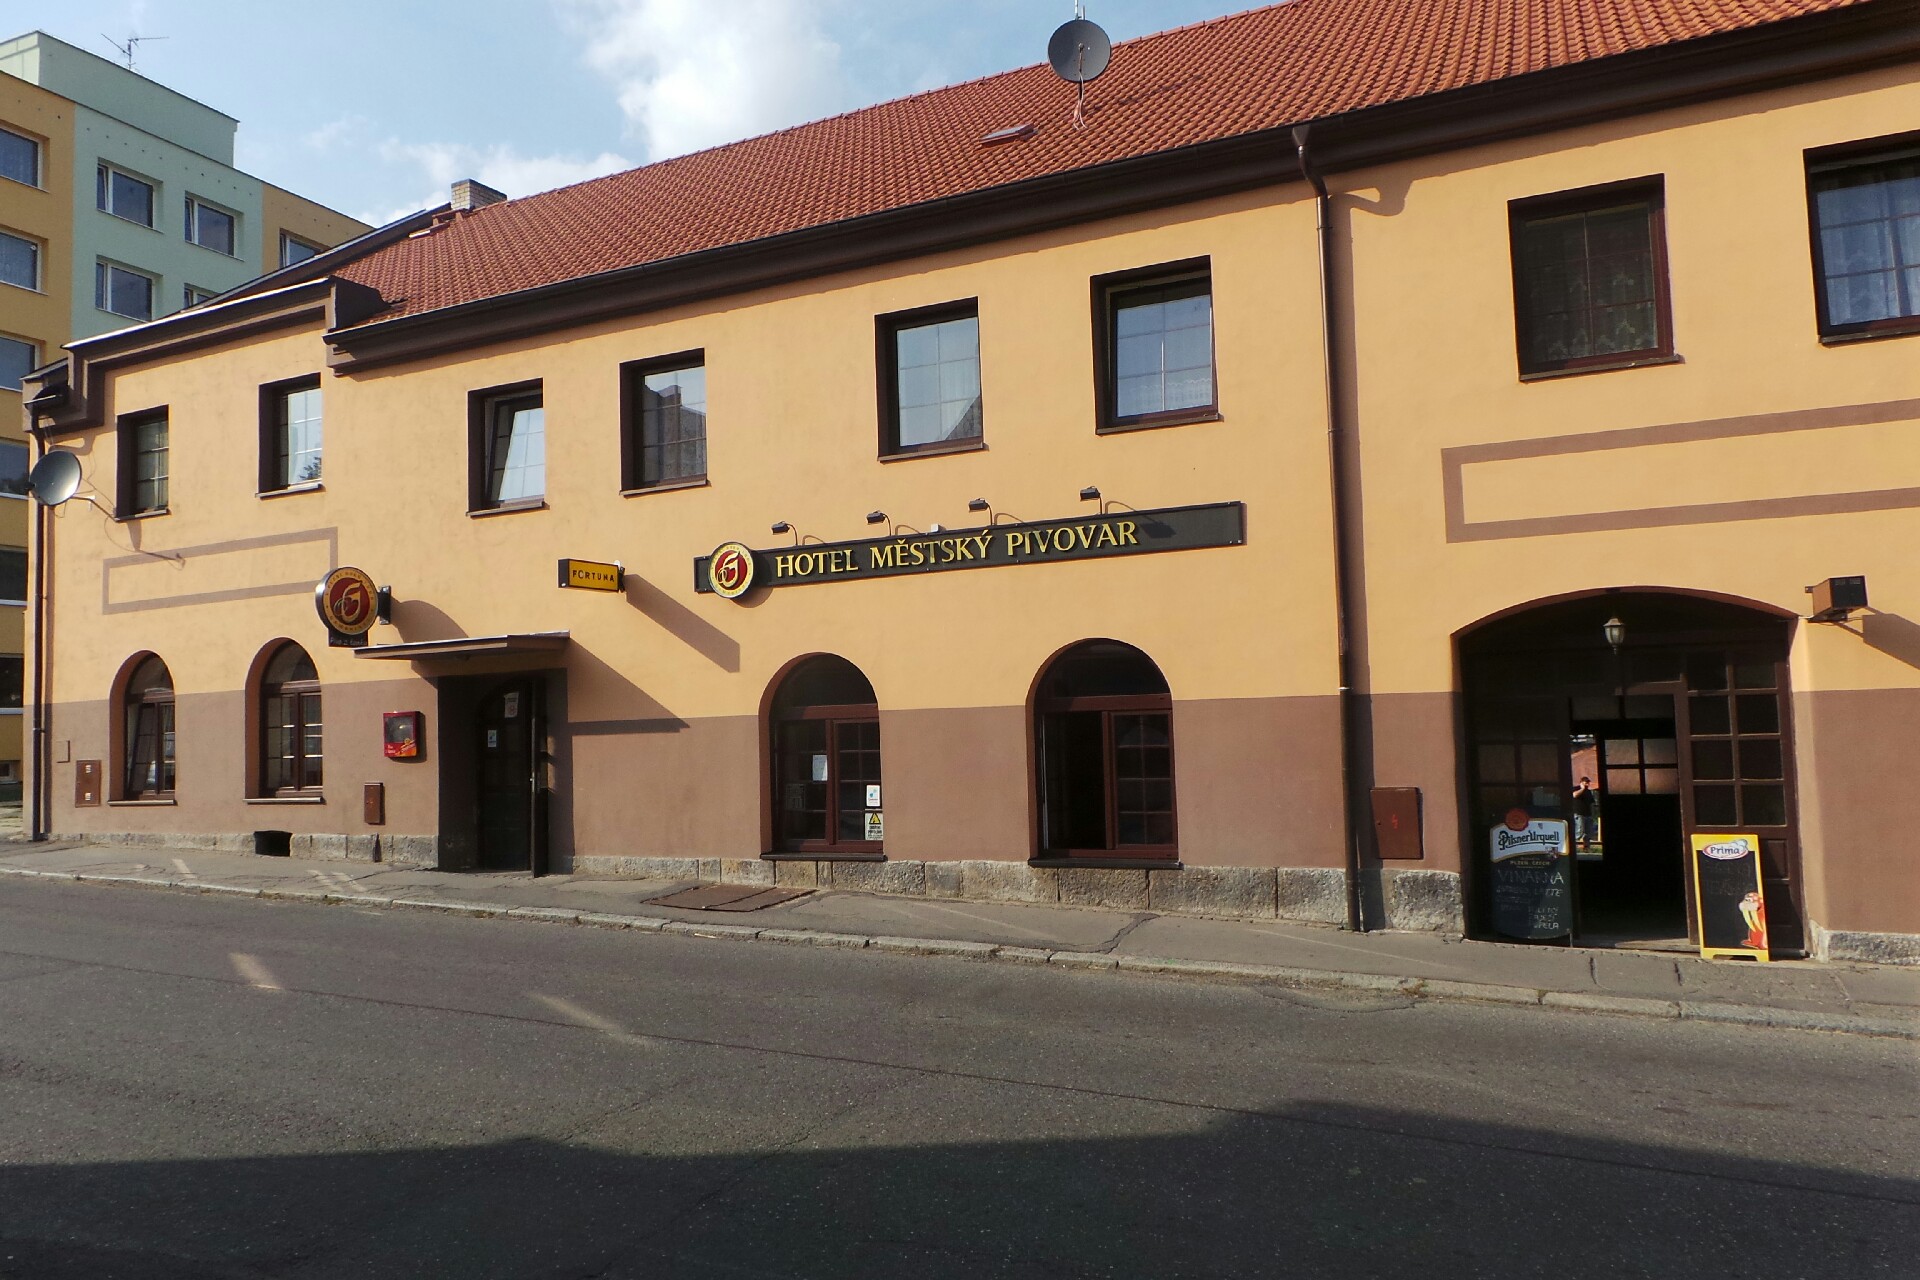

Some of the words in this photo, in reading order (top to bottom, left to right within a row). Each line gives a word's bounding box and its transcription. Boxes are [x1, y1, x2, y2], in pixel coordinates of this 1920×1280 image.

[775, 549, 859, 578] HOTEL
[870, 530, 993, 569] MĚSTSKÝ
[1006, 521, 1138, 556] PIVOVAR
[572, 569, 615, 583] FORTUNA
[1498, 830, 1530, 851] Pilsner
[1528, 829, 1560, 846] Urquell
[1710, 845, 1741, 856] Prima
